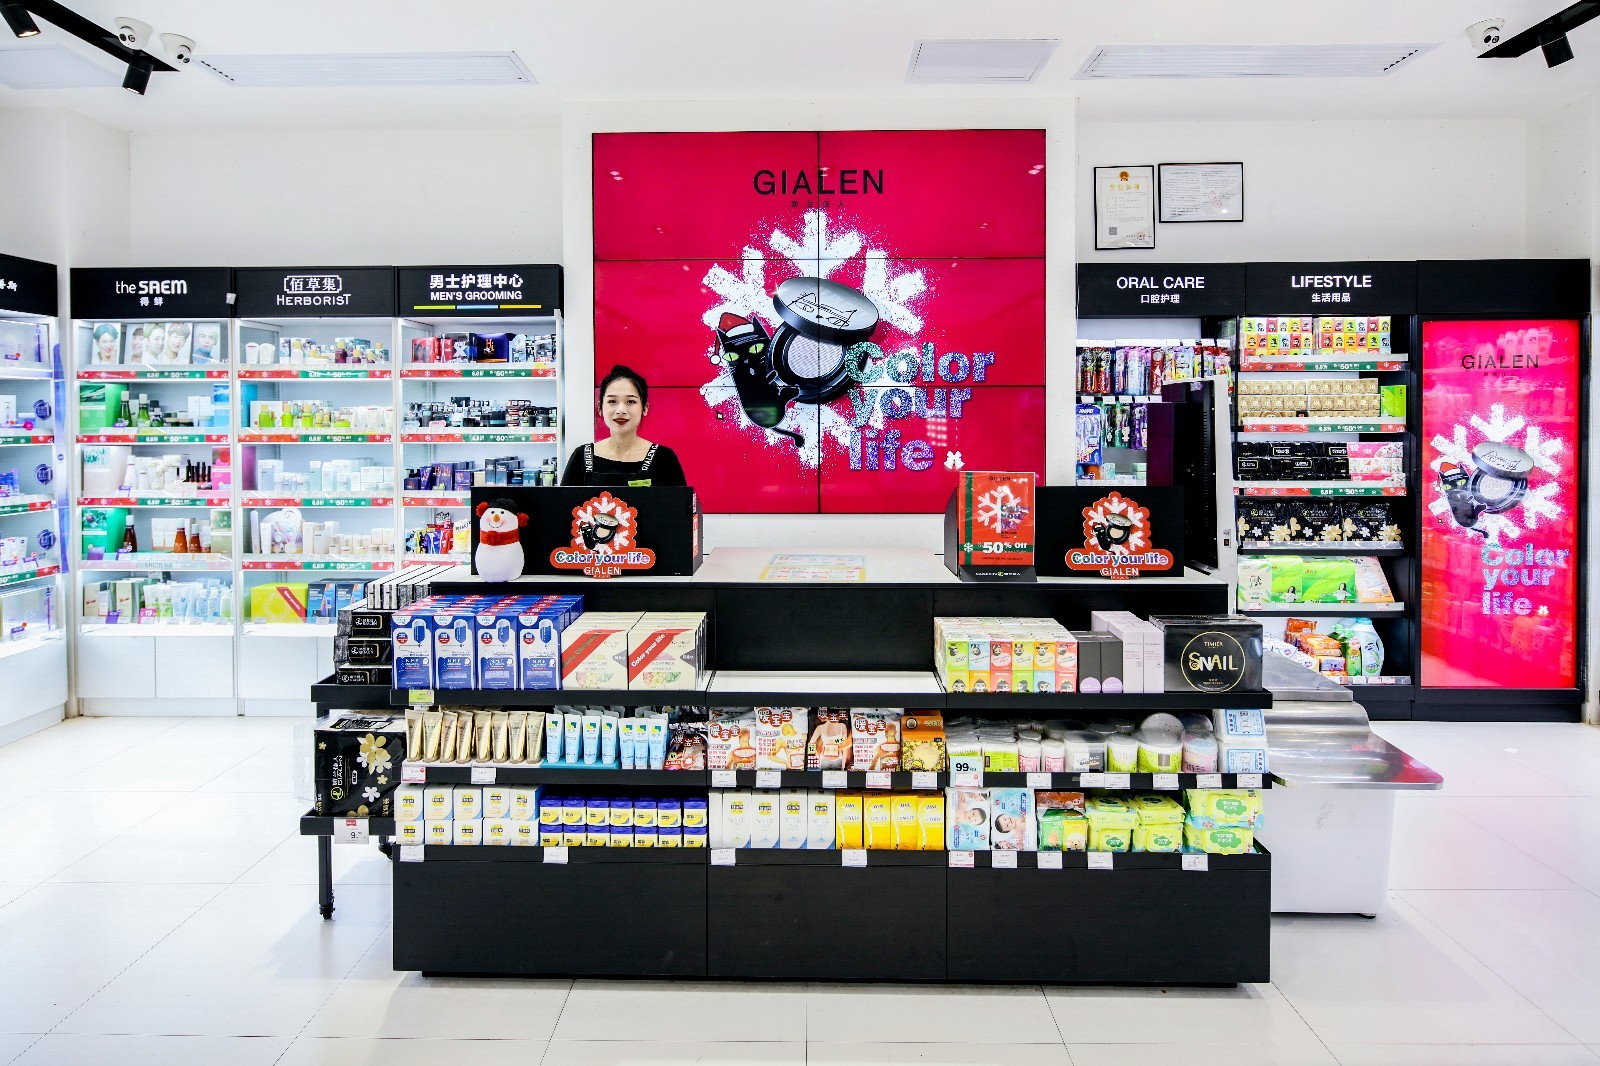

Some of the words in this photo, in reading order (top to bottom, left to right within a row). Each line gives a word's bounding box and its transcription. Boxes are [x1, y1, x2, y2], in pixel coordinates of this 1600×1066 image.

[753, 170, 883, 195] GIALEN
[116, 281, 136, 294] the
[138, 280, 188, 294] SAEM
[289, 276, 338, 292] 佰草集
[430, 274, 524, 289] 男士护理中心
[1116, 276, 1158, 289] ORAL
[1164, 276, 1205, 289] CARE
[1291, 275, 1372, 288] LIFESTYLE
[276, 294, 352, 306] HERBORIST
[430, 291, 463, 301] MEN'S
[465, 290, 522, 300] GROOMING
[1140, 294, 1180, 304] 口腔护理
[1311, 292, 1351, 302] 生活用品
[845, 341, 994, 383] Color
[1461, 355, 1540, 370] GIALEN
[848, 388, 972, 428] your
[850, 430, 934, 471] life
[555, 551, 594, 564] Color
[596, 552, 626, 566] your
[628, 551, 650, 564] life
[1072, 552, 1110, 564] Color
[1112, 553, 1144, 566] your
[1145, 552, 1169, 564] life
[1481, 543, 1569, 566] Color
[584, 566, 621, 576] GIALEN
[1102, 568, 1139, 576] GIALEN
[1482, 568, 1556, 590] your
[1482, 592, 1532, 615] life
[631, 654, 646, 667] Color
[645, 644, 658, 656] your
[655, 634, 665, 645] life
[1188, 652, 1238, 671] SNAIL
[758, 708, 792, 726] 暖宝宝
[710, 723, 740, 741] 暖宝宝
[854, 718, 886, 734] 暖宝宝
[956, 763, 969, 772] 99
